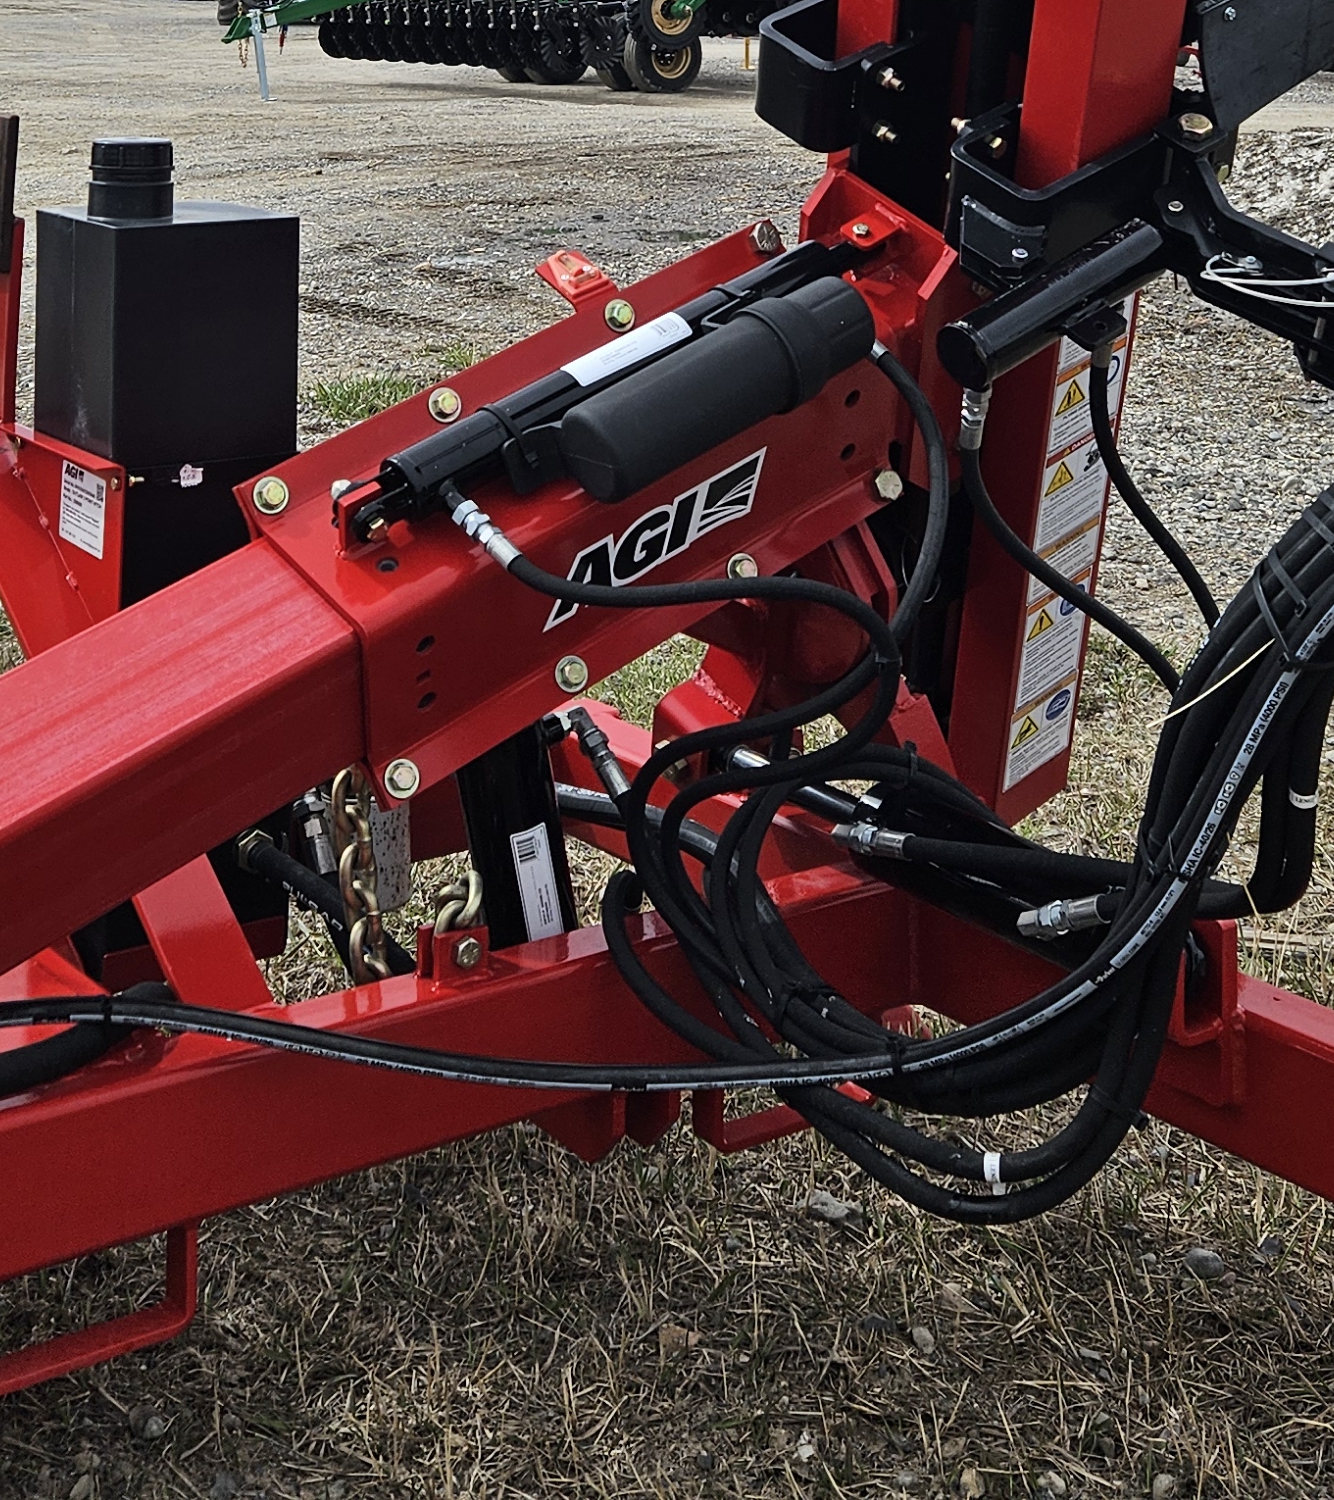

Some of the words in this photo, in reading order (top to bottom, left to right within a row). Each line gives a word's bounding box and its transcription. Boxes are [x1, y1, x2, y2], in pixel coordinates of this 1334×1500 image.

[64, 463, 78, 480] AGI
[543, 486, 702, 633] AGI
[1243, 743, 1255, 756] 28
[1249, 722, 1267, 744] MPa
[1259, 699, 1279, 723] (4000
[1272, 681, 1289, 701] PSI)
[1191, 822, 1216, 861] IC-40/26
